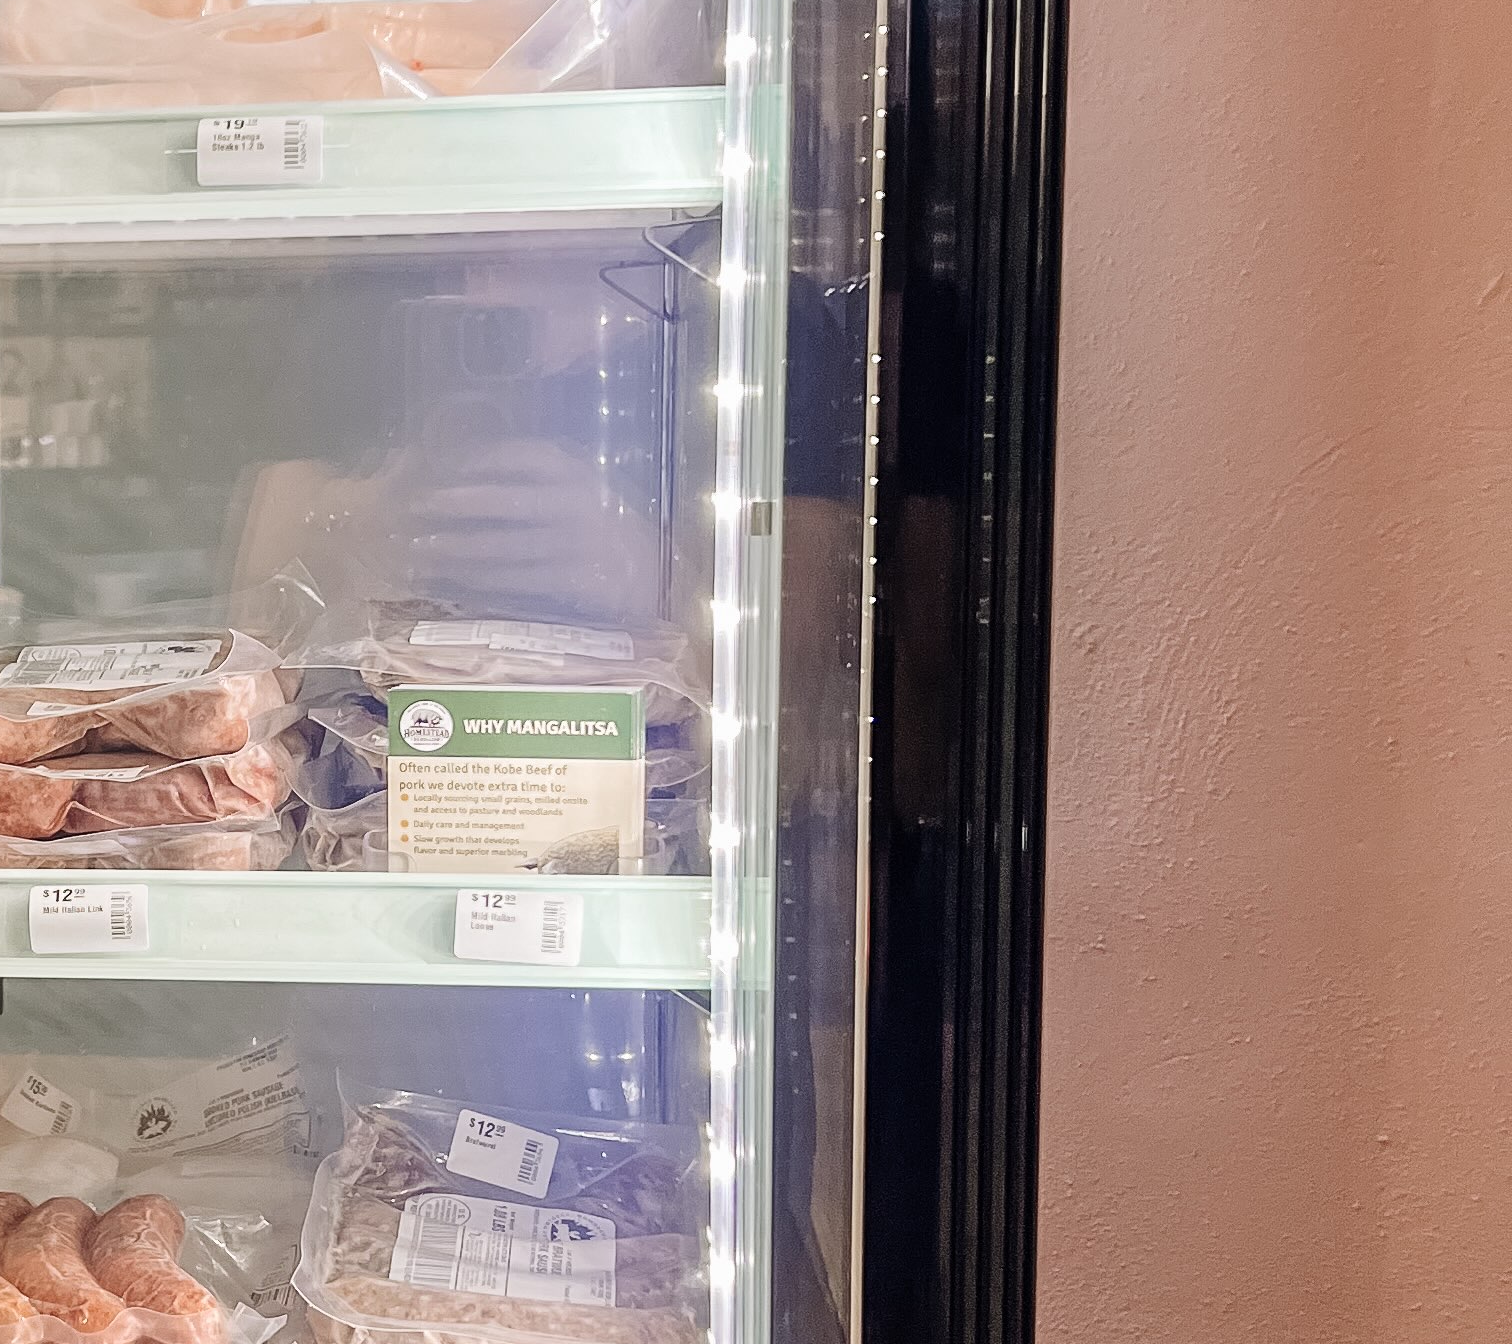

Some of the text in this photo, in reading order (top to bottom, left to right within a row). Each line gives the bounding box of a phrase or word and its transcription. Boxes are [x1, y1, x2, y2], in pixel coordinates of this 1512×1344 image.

[462, 719, 504, 734] WHY
[507, 720, 619, 736] MANGALITSA
[399, 762, 568, 776] Often called the Kobe Beef of
[399, 780, 566, 792] pork we devote extra time to:
[414, 794, 442, 803] Locally
[481, 795, 502, 803] small
[459, 806, 468, 814] to
[502, 807, 517, 815] and
[414, 820, 434, 829] Daily
[455, 821, 470, 829] and
[472, 822, 525, 832] management
[414, 835, 520, 845] Slow growth that develops
[439, 847, 454, 855] and
[456, 847, 489, 856] superior
[490, 1218, 506, 1233] LBS
